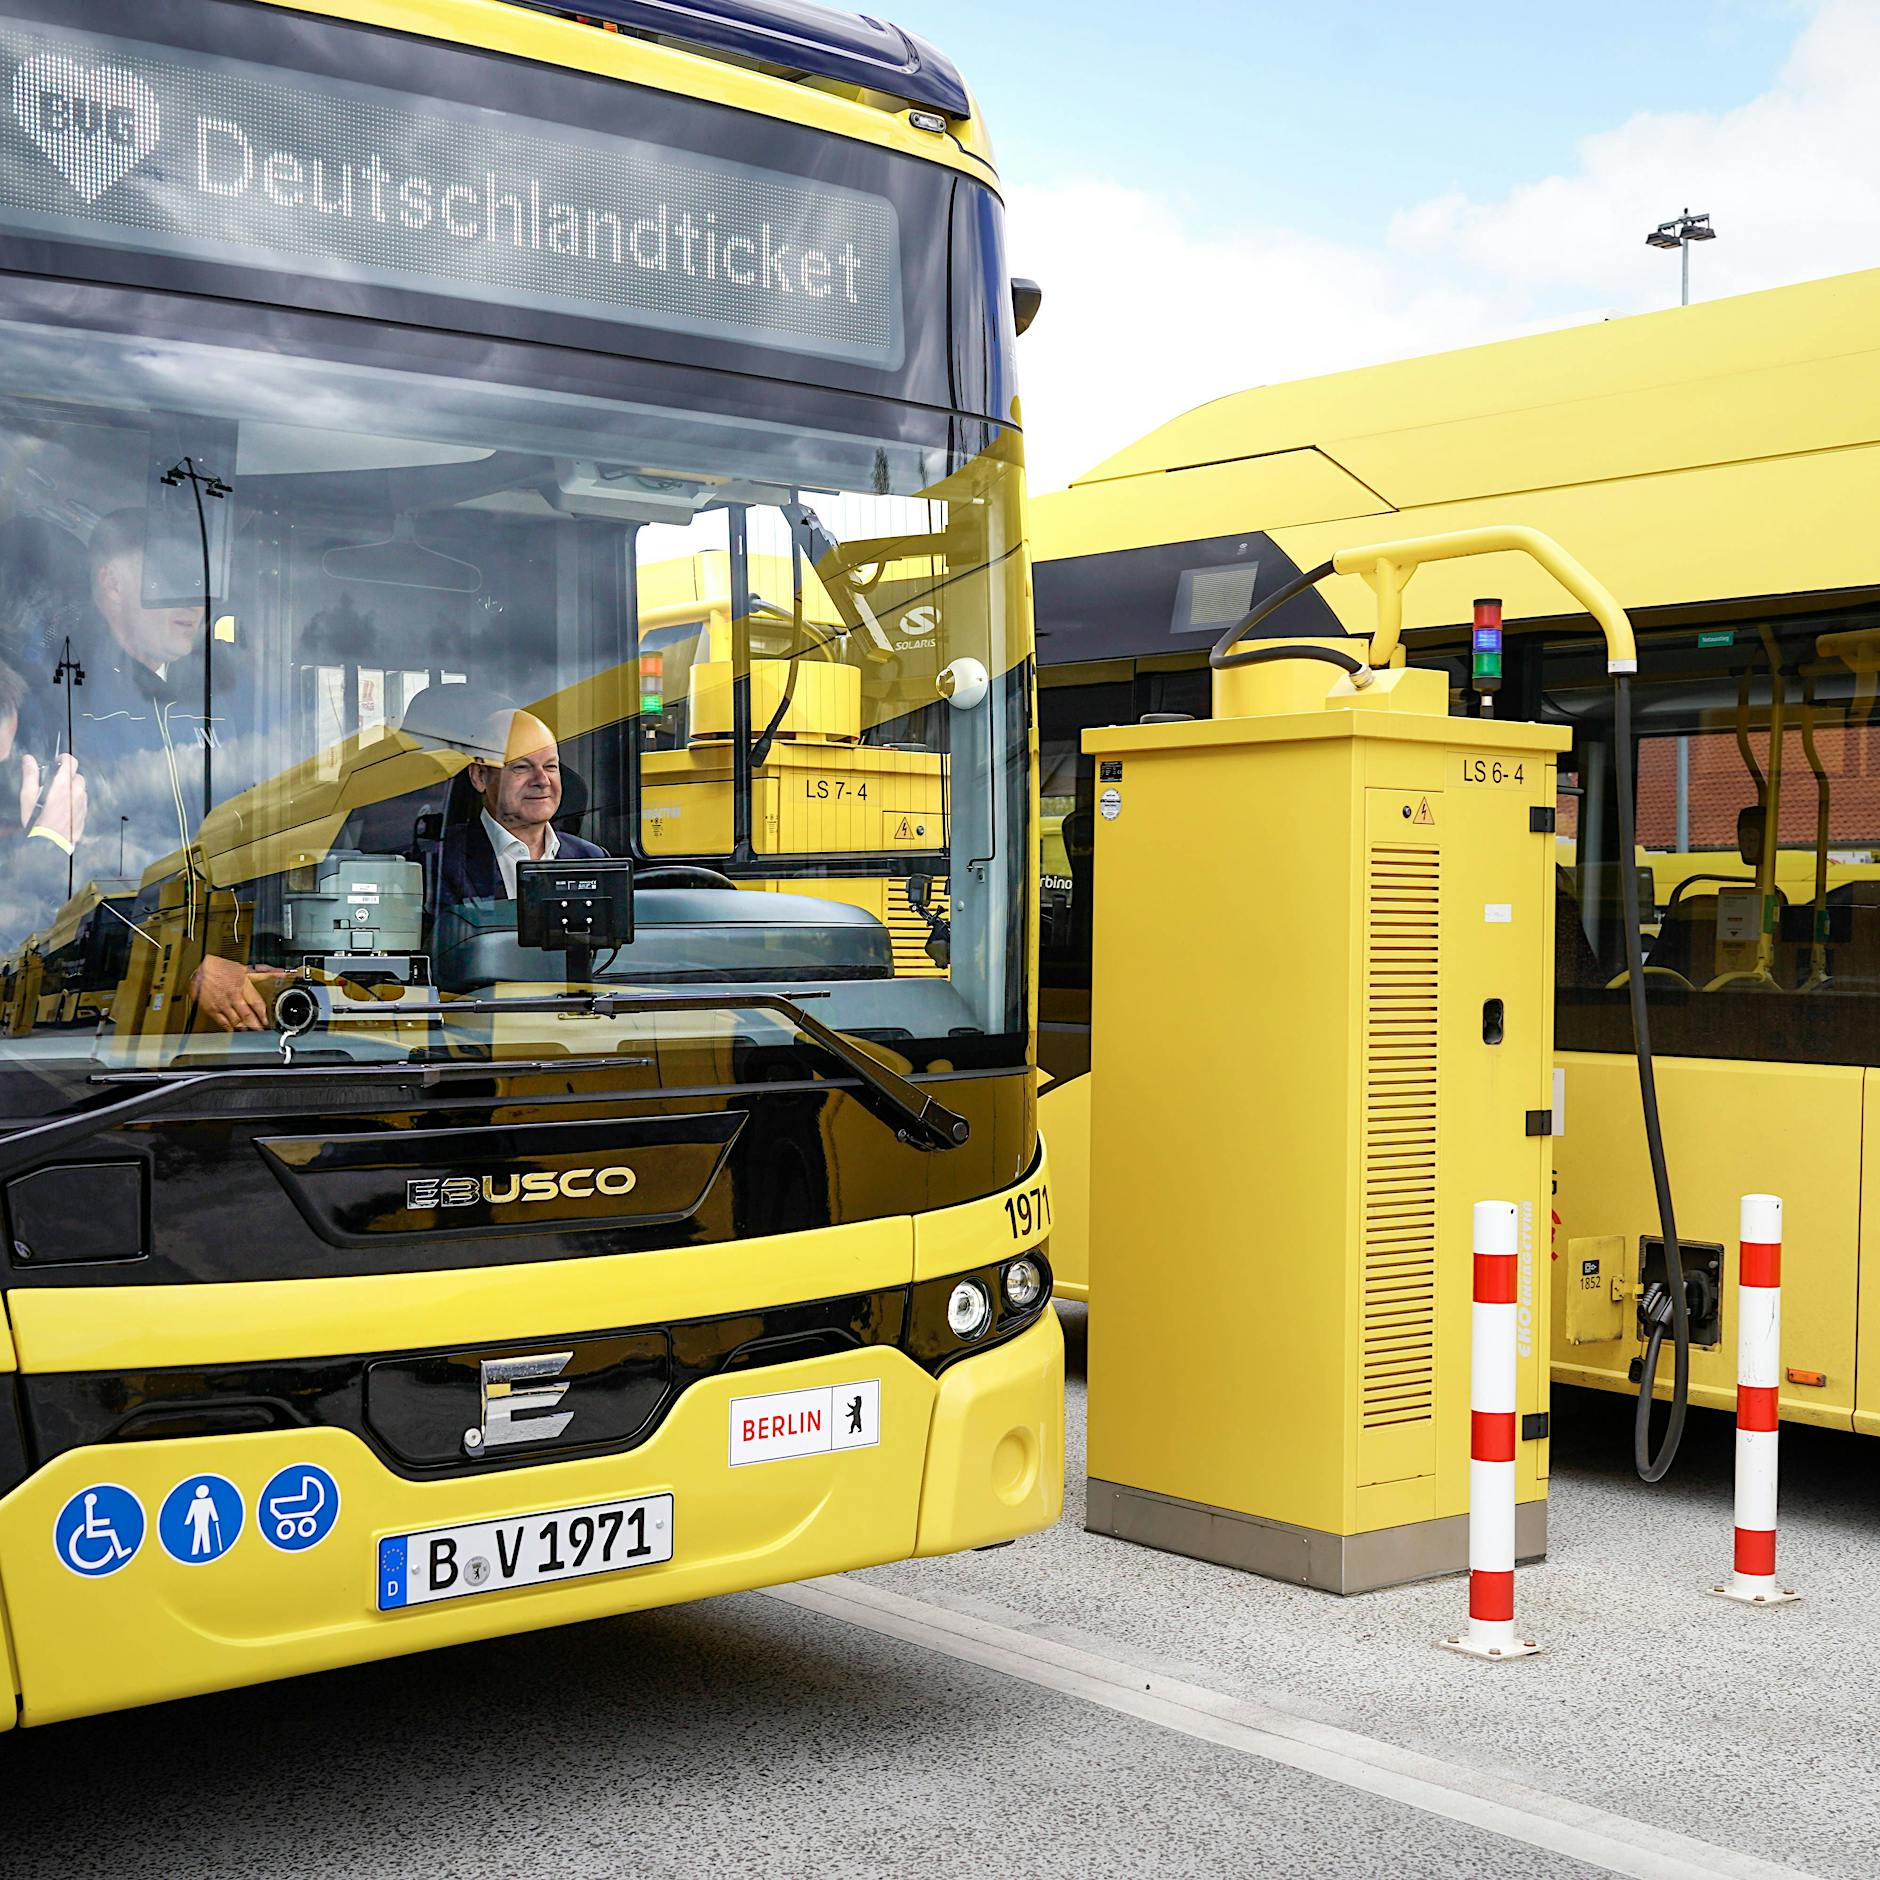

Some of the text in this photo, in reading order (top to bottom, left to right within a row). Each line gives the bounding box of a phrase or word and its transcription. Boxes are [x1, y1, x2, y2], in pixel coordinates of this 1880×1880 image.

[197, 116, 861, 303] Deutschlandticket
[895, 638, 937, 651] SOLARIS
[1463, 759, 1486, 783] LS
[806, 779, 829, 799] LS
[406, 1166, 637, 1210] EBUSCO
[1004, 1184, 1051, 1239] 1971
[1580, 1275, 1601, 1291] 1852
[742, 1409, 821, 1442] BERLIN
[429, 1537, 459, 1592] B
[387, 1580, 399, 1597] D
